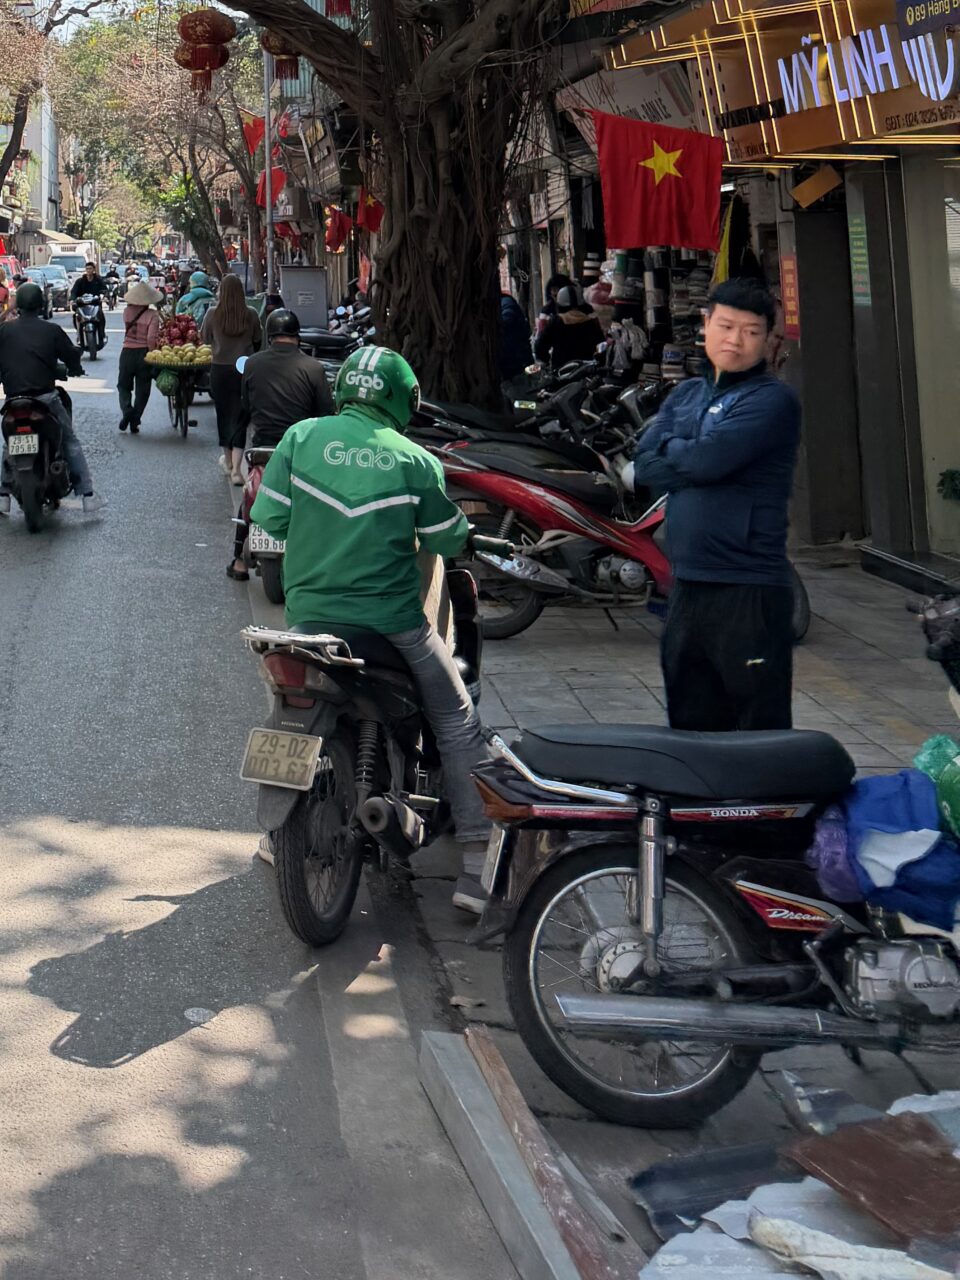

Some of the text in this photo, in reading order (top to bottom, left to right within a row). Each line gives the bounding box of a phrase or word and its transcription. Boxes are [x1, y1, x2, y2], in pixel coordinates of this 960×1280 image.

[914, 4, 926, 21] 89
[777, 24, 899, 114] MỸ LINH
[345, 370, 384, 390] Grab
[323, 440, 396, 471] Grab
[257, 733, 310, 760] 29-D2
[710, 809, 760, 817] HONDA
[765, 908, 828, 921] Dream
